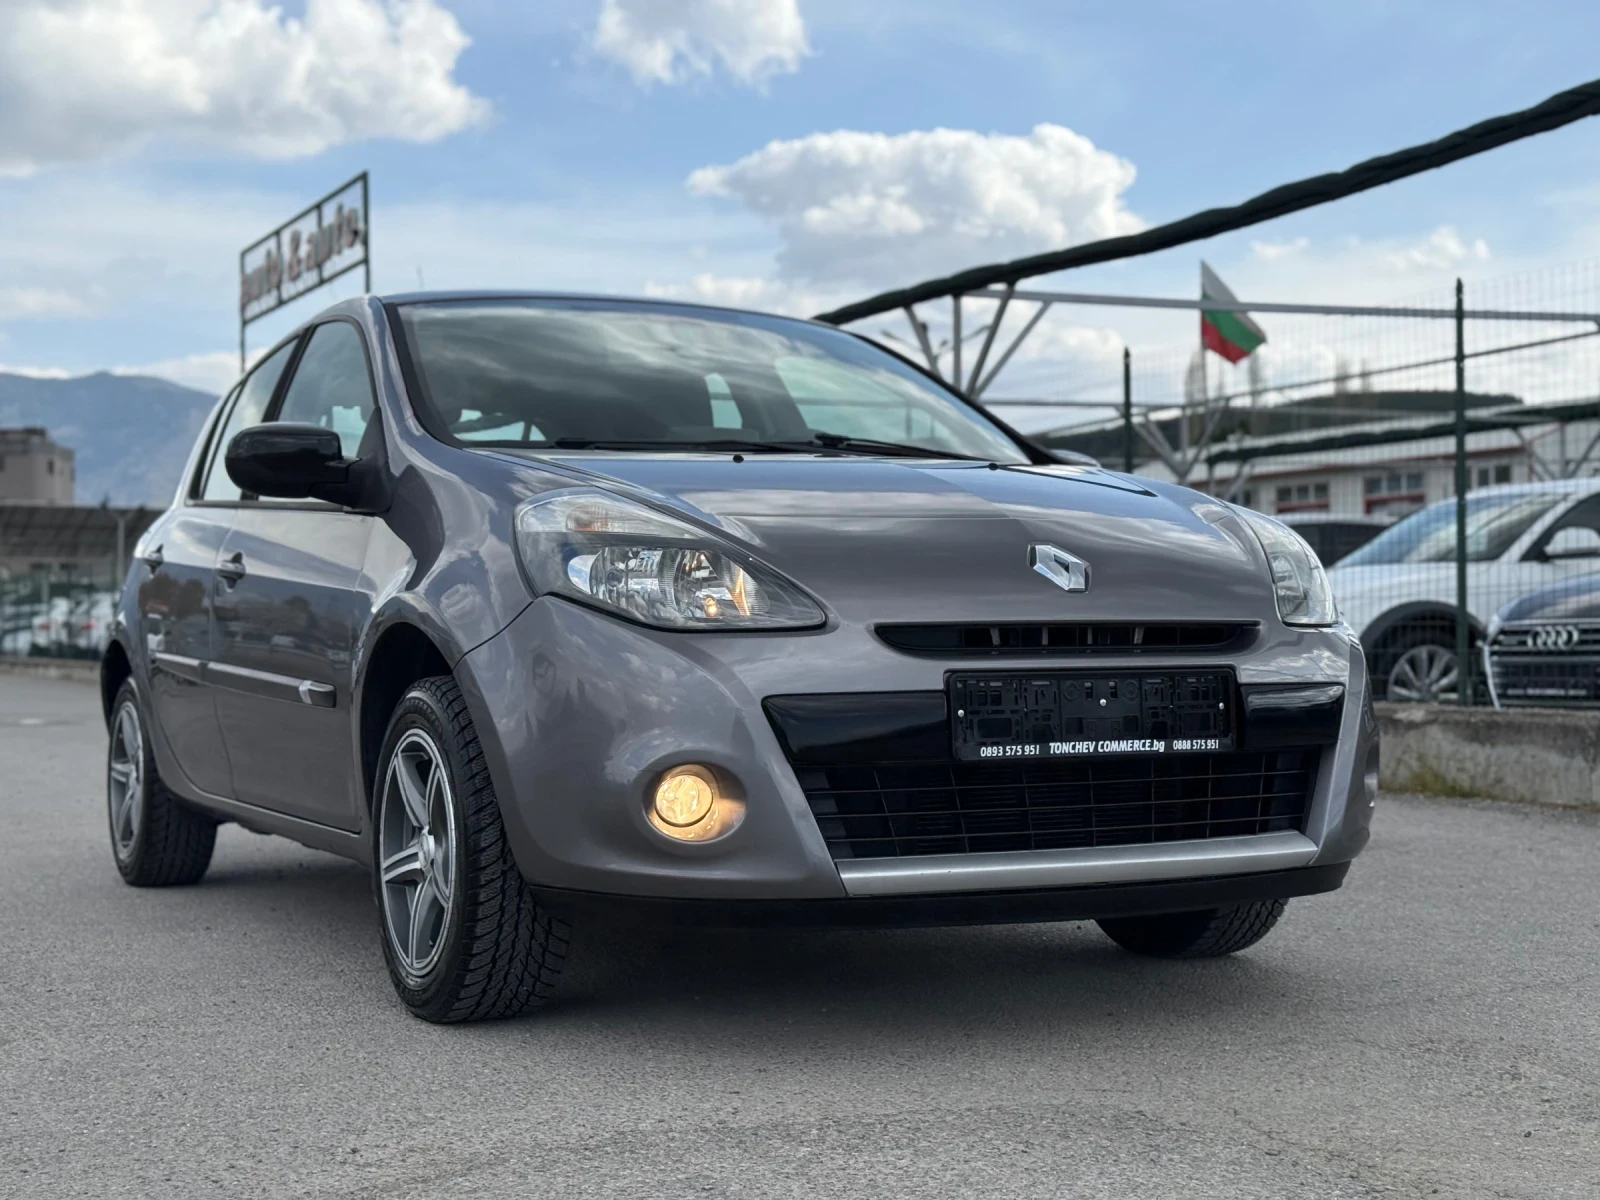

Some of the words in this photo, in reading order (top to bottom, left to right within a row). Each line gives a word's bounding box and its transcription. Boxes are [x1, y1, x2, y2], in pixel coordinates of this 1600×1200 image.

[980, 746, 1003, 757] 0893
[1005, 745, 1022, 756] 575
[1024, 744, 1040, 755] 951
[1049, 741, 1096, 754] TONCHEV
[1097, 739, 1165, 753] COMMERCE.bg
[1172, 740, 1191, 750] 0888
[1192, 739, 1206, 749] 575
[1206, 739, 1219, 749] 951
